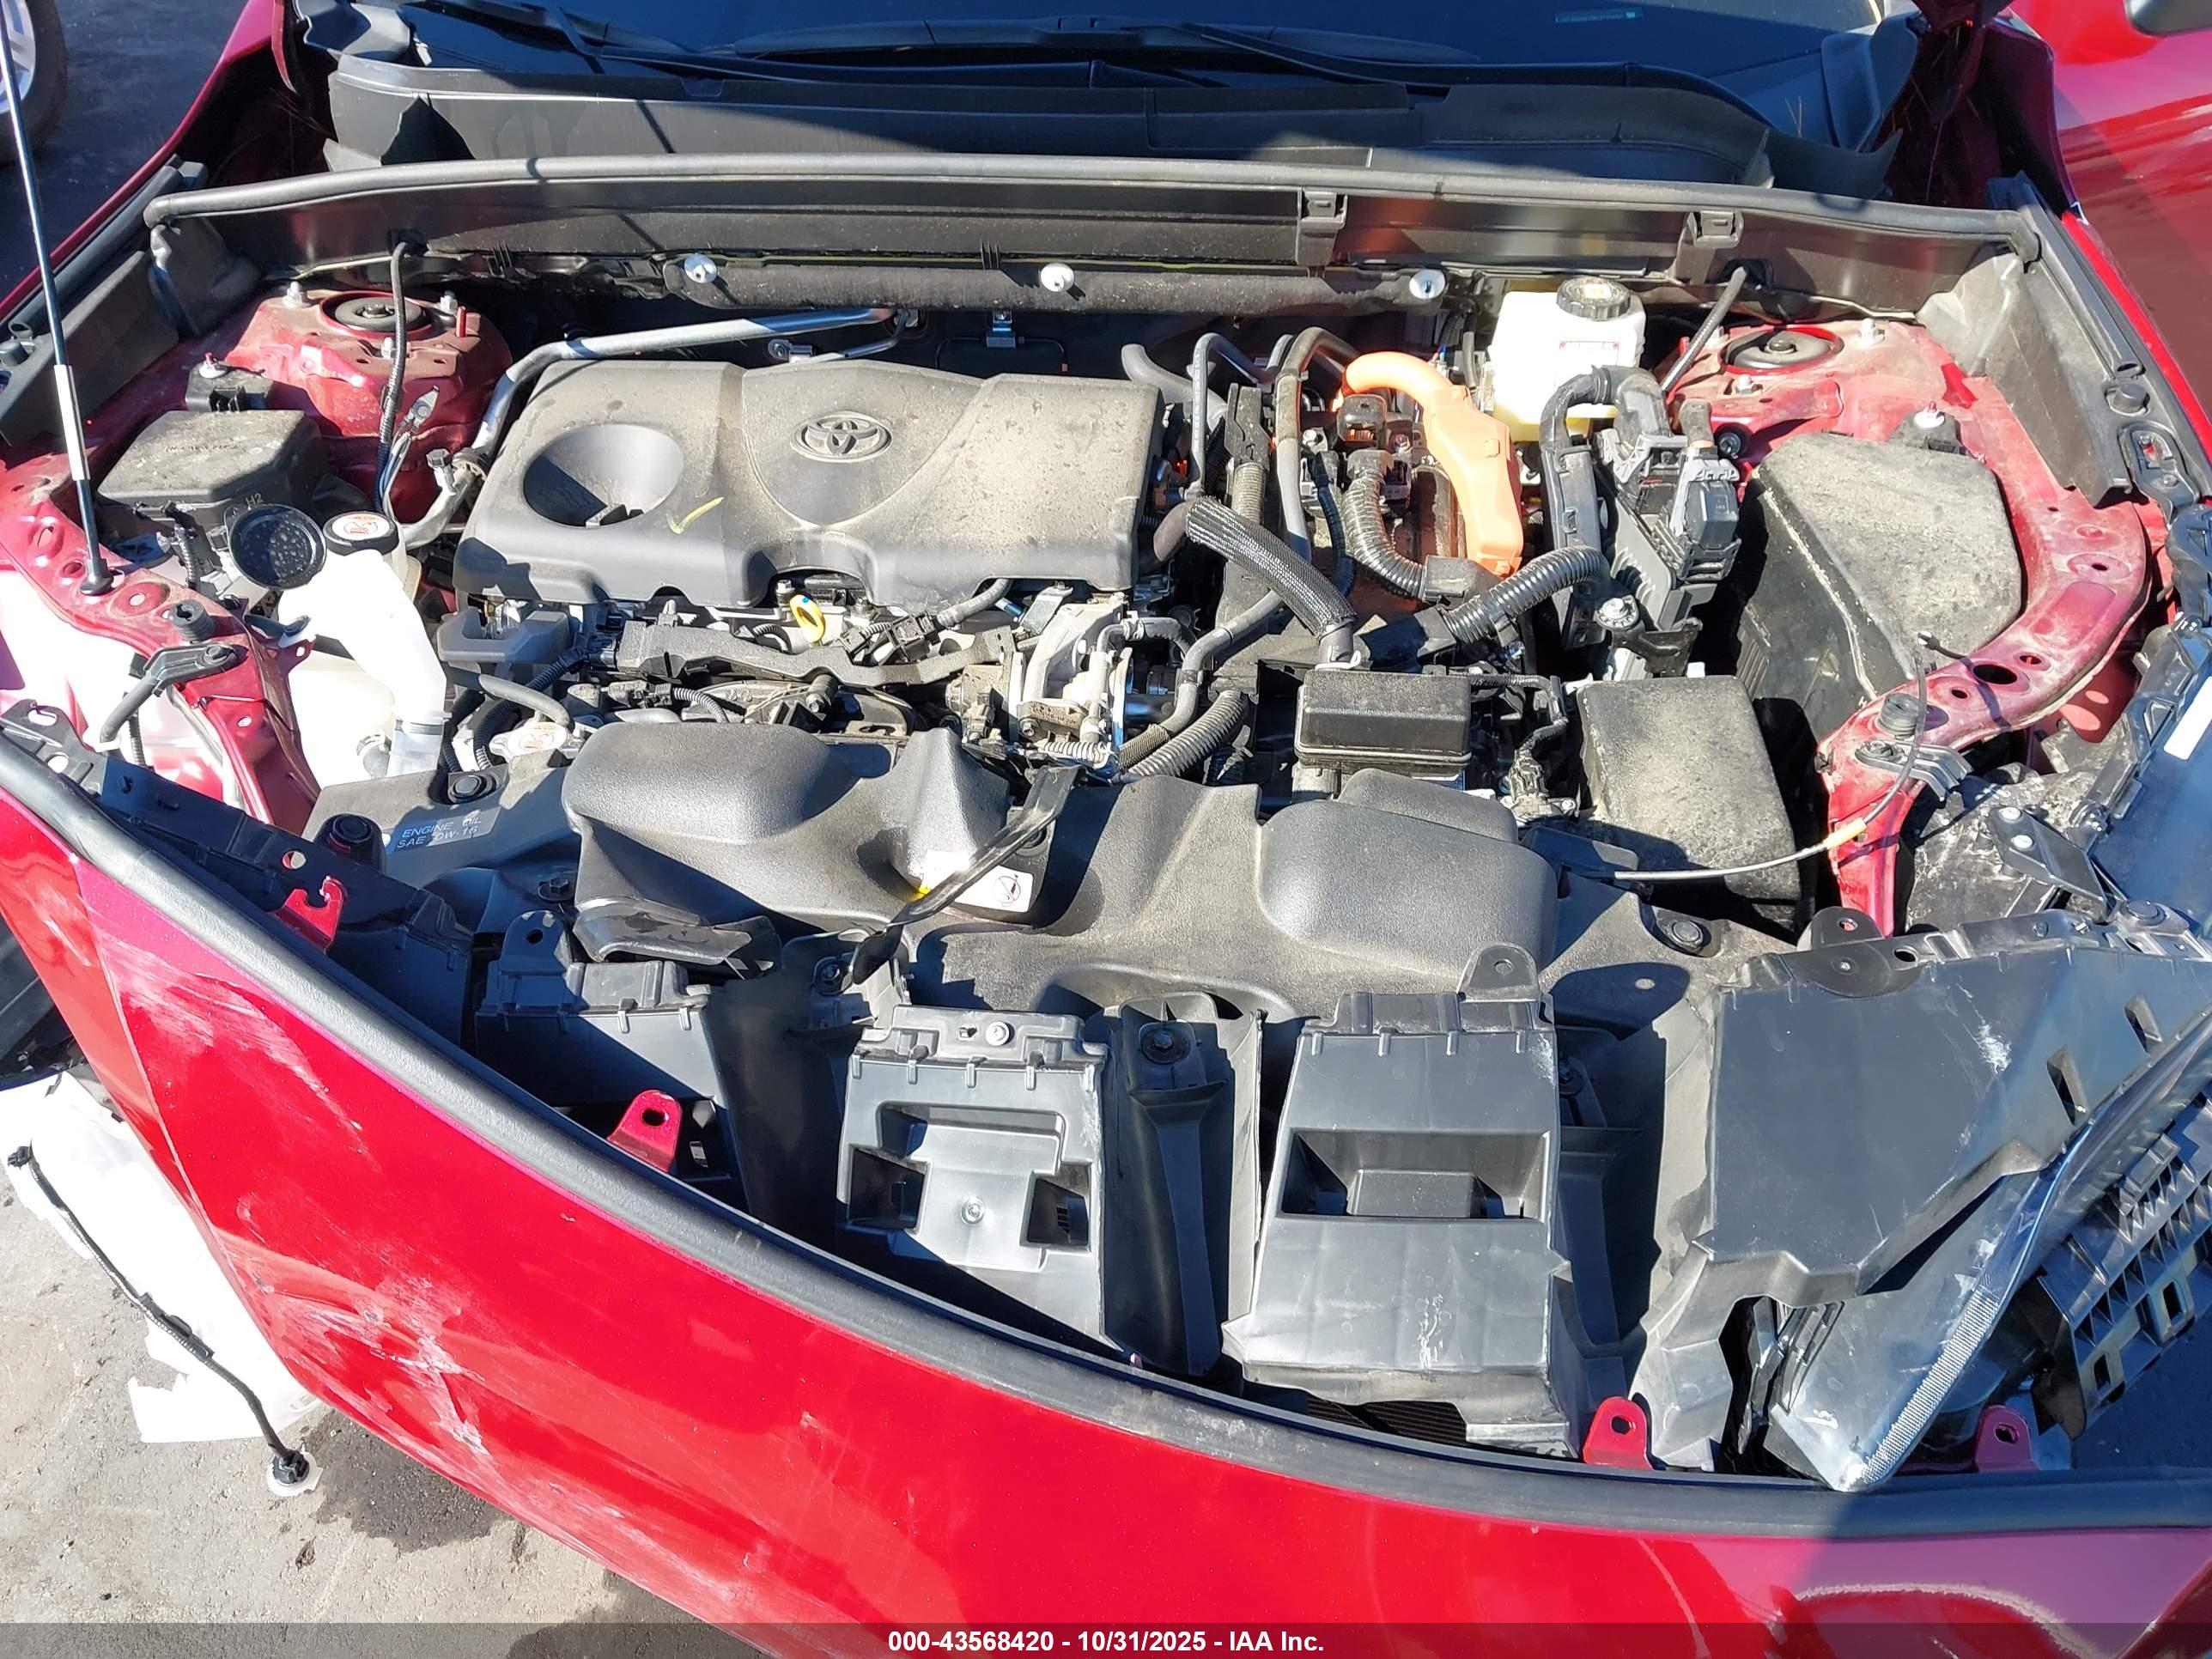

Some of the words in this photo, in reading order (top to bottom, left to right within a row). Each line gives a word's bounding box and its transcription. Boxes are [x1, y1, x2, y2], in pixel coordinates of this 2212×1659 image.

[402, 822, 454, 838] ENGINE
[462, 817, 482, 827] OIL
[397, 836, 427, 848] SAE
